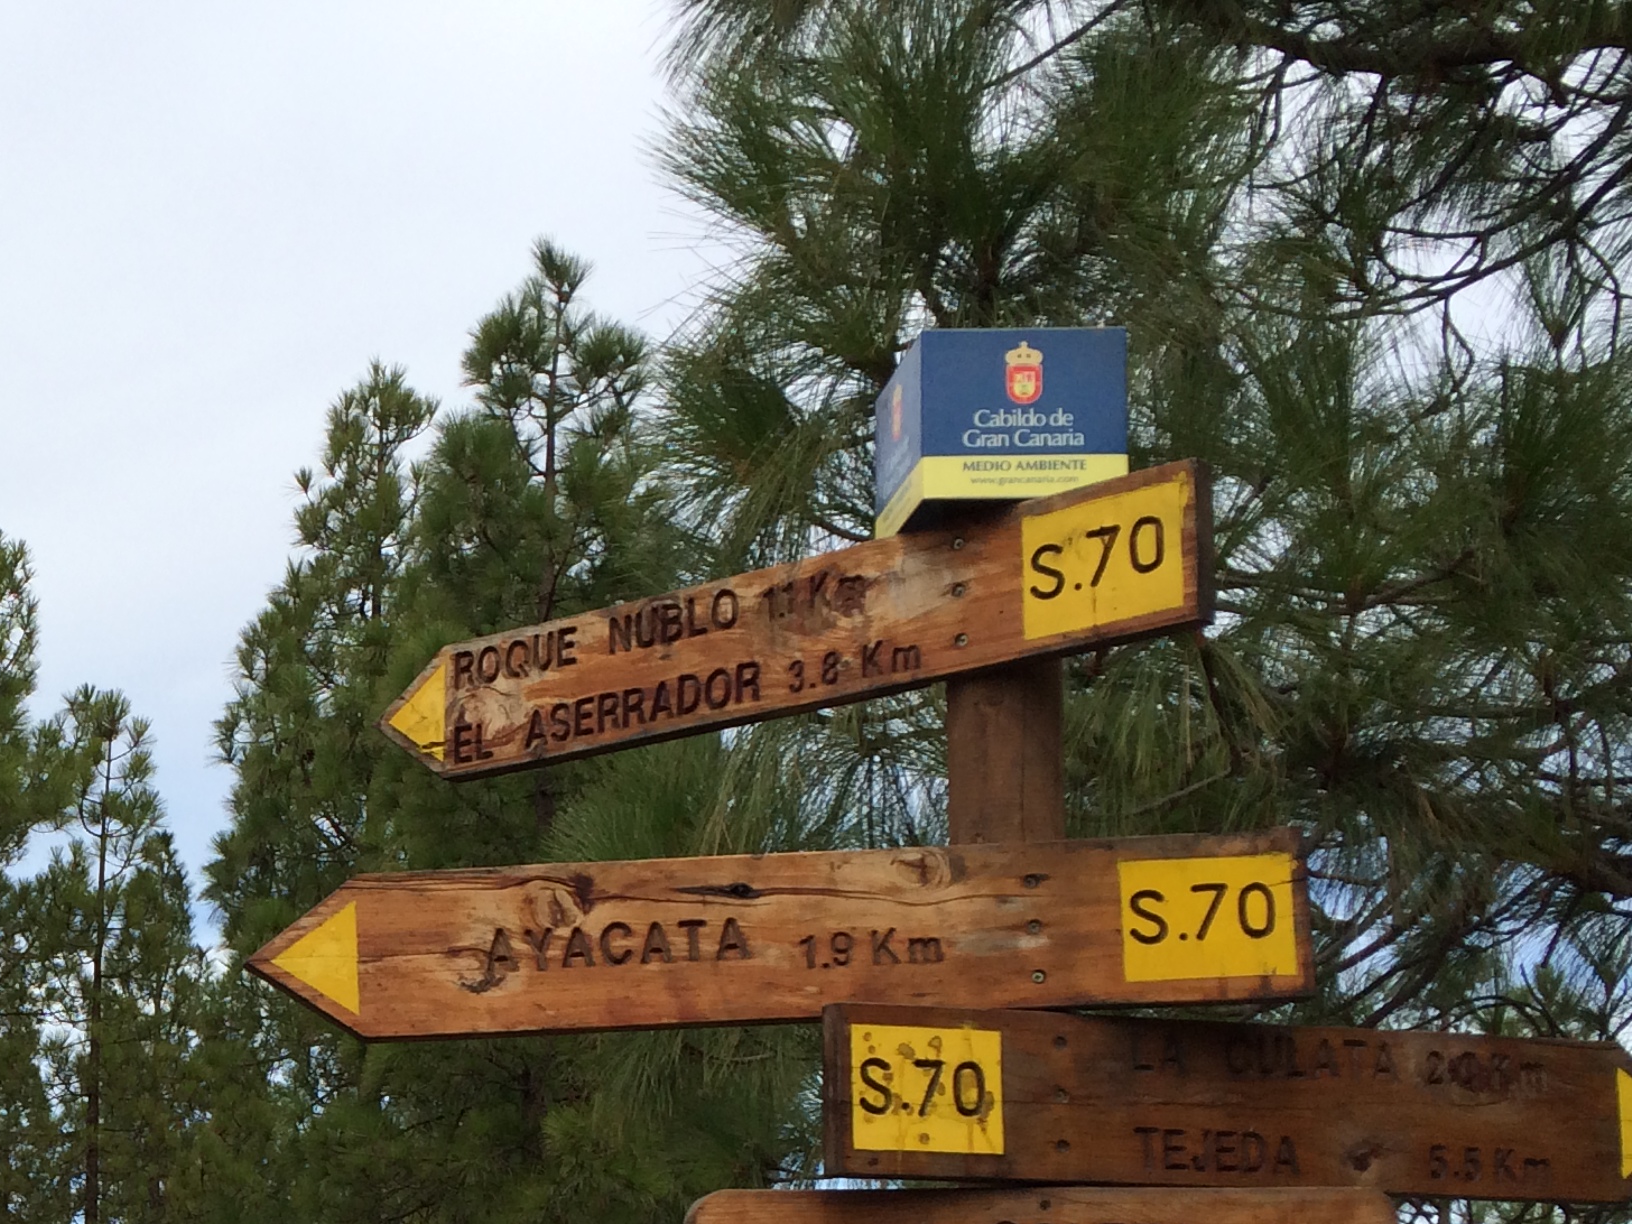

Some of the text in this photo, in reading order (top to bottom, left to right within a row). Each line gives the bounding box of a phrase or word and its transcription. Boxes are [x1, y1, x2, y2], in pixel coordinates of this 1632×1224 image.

[962, 429, 1085, 447] Gran Canaria
[973, 408, 1074, 427] Cabildo de
[962, 459, 1087, 471] MEDIO AMBIENTE
[970, 475, 1079, 486] www.grancanaria.com
[1030, 515, 1165, 600] S.70
[452, 626, 579, 692] ROQUE
[608, 588, 738, 654] NUBLO
[454, 640, 921, 764] EL ASERRADOR 3.8 Km
[1129, 881, 1276, 945] S.70
[486, 917, 945, 973] AYACATA 1.9 Km
[1132, 1034, 1187, 1076] LA
[1225, 1037, 1399, 1084] CULATA
[859, 1057, 986, 1118] S.70
[1133, 1127, 1551, 1184] TEJEDA 5.5 Km
